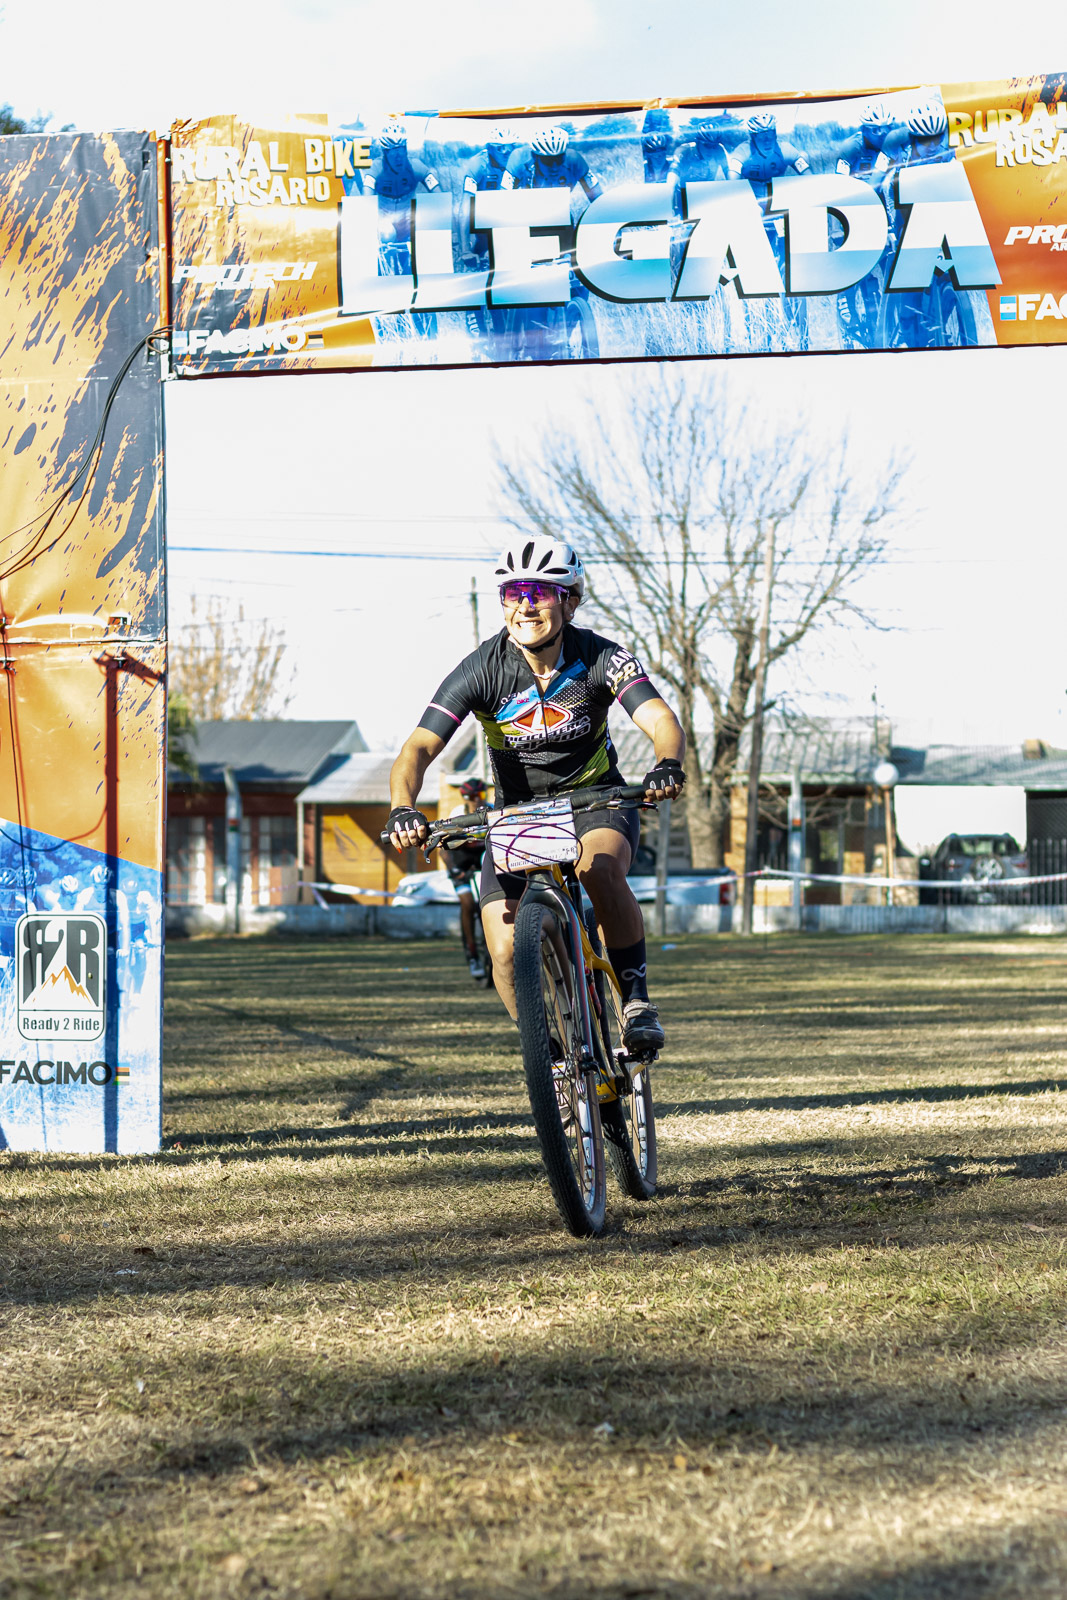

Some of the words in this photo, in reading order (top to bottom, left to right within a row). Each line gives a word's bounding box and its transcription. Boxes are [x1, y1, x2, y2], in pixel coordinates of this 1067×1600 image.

[172, 141, 289, 186] RURAL
[304, 137, 373, 179] BIKE
[215, 174, 331, 207] ROSARIO
[337, 161, 1003, 317] LLEGADA
[22, 1017, 60, 1032] Ready
[63, 1017, 70, 1031] 2
[73, 1017, 100, 1031] Ride
[0, 1060, 113, 1086] FACIMO
